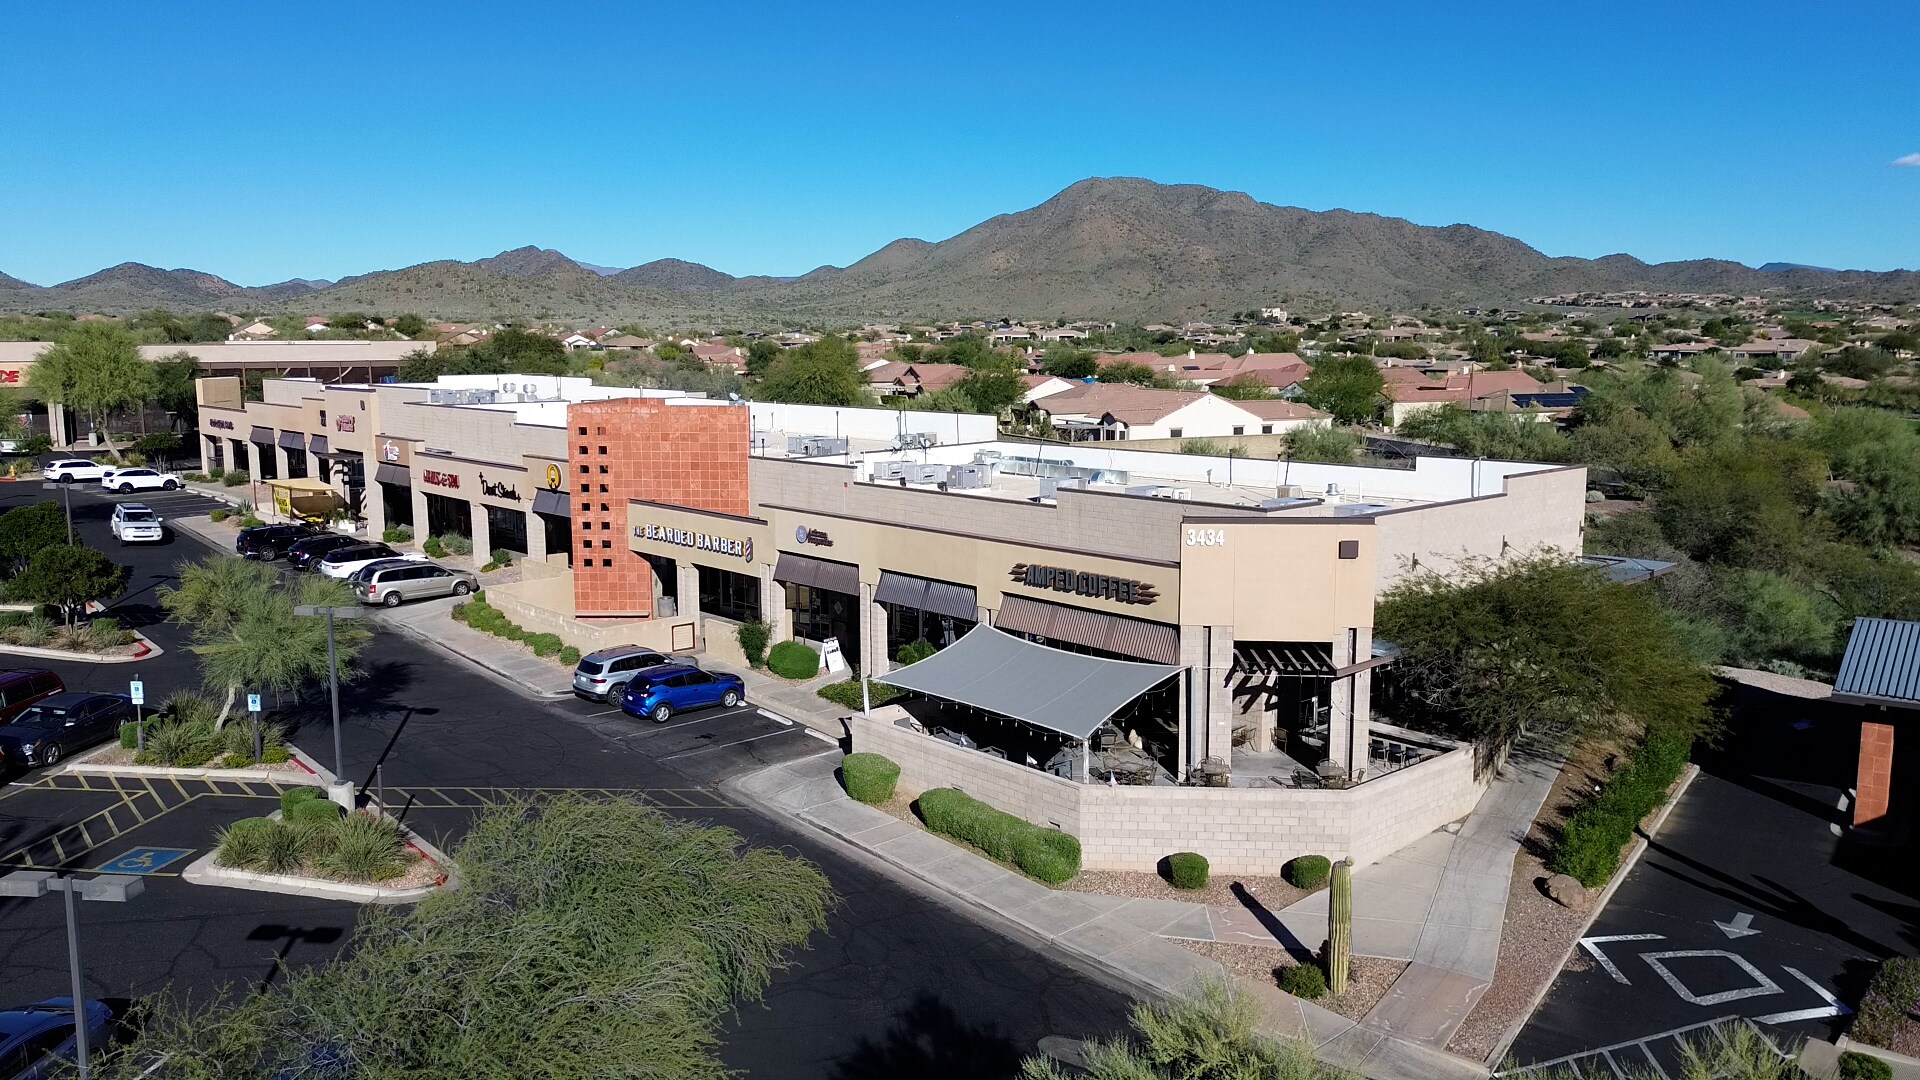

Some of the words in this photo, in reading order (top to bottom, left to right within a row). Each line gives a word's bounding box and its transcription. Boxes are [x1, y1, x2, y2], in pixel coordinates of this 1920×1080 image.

[633, 526, 645, 538] THE
[645, 524, 696, 547] BEARDED
[696, 533, 745, 557] BARBER
[1186, 529, 1225, 546] 3434
[1024, 564, 1077, 593] AMPED
[1076, 571, 1141, 605] COFFEE
